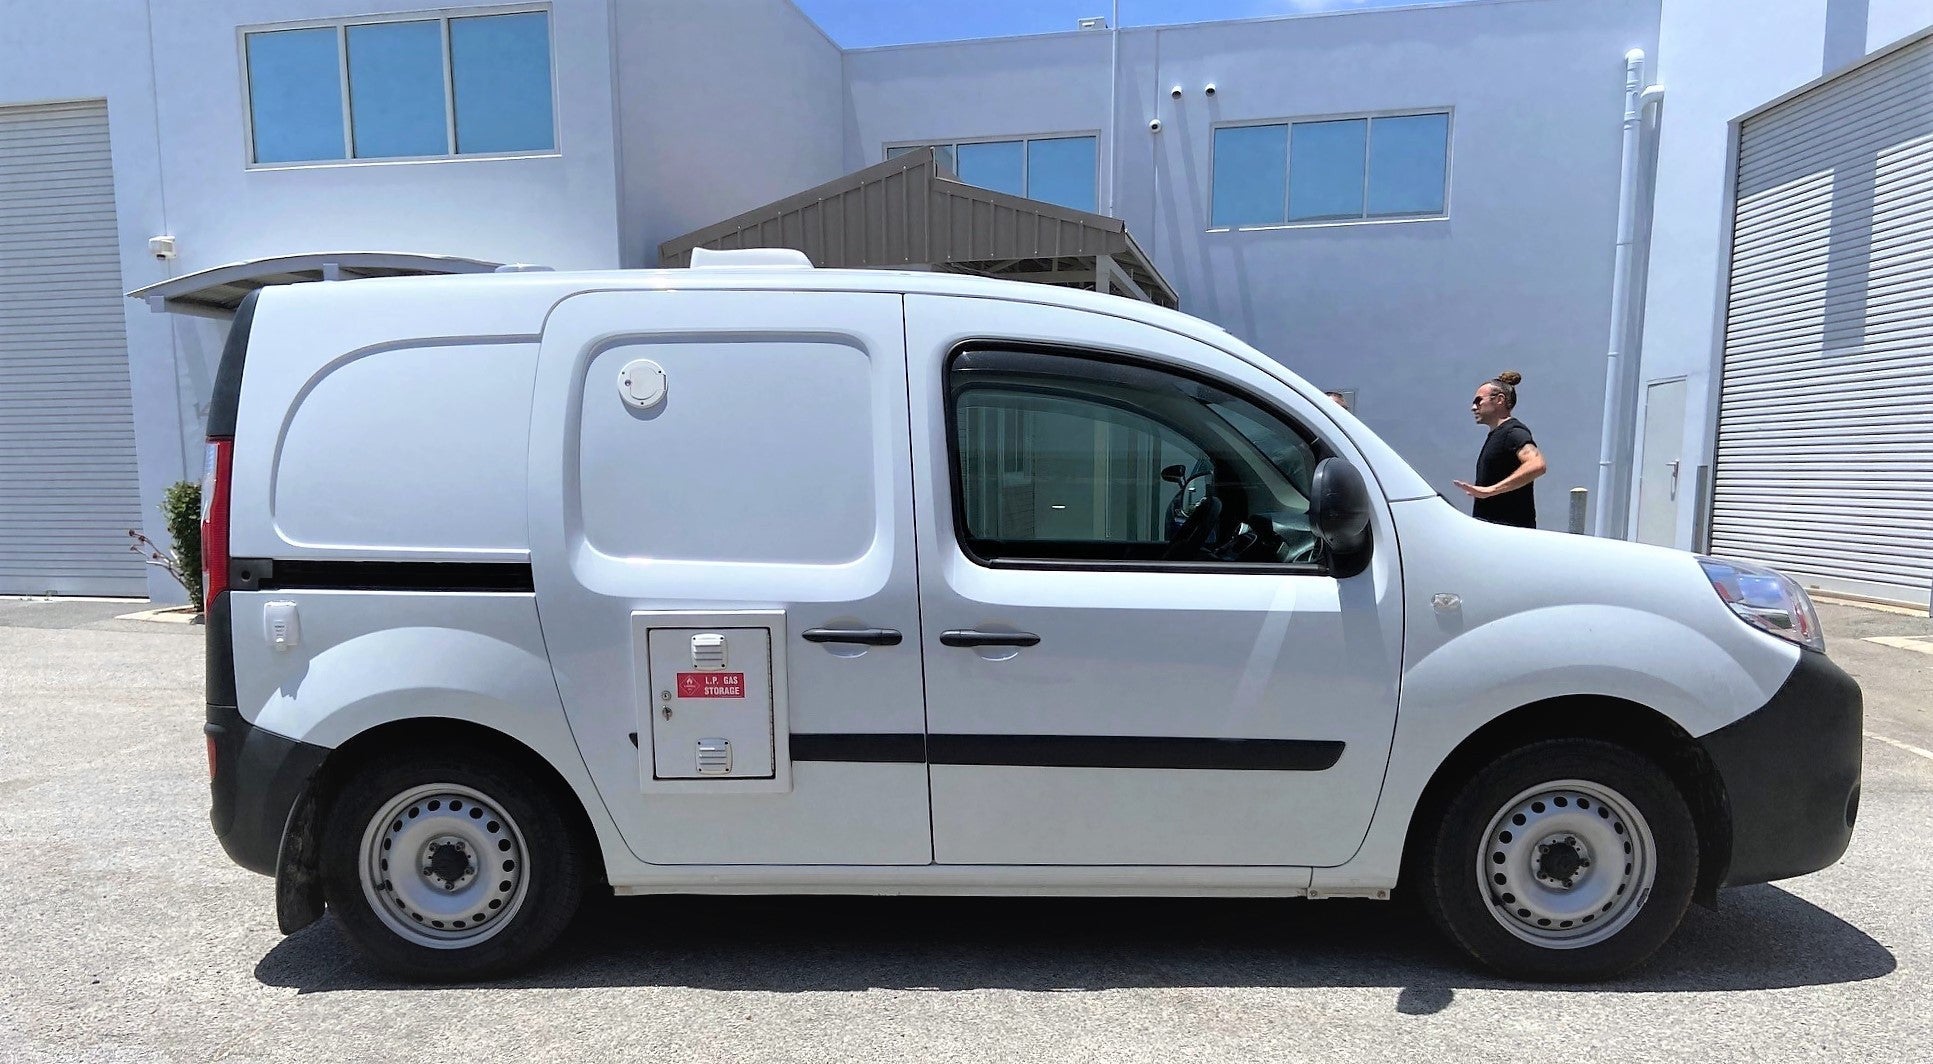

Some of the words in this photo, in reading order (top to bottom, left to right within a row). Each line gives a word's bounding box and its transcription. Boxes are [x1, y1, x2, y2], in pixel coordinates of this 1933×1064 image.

[705, 676, 719, 685] L.P.
[723, 676, 738, 685] GAS
[704, 686, 740, 695] STORAGE
